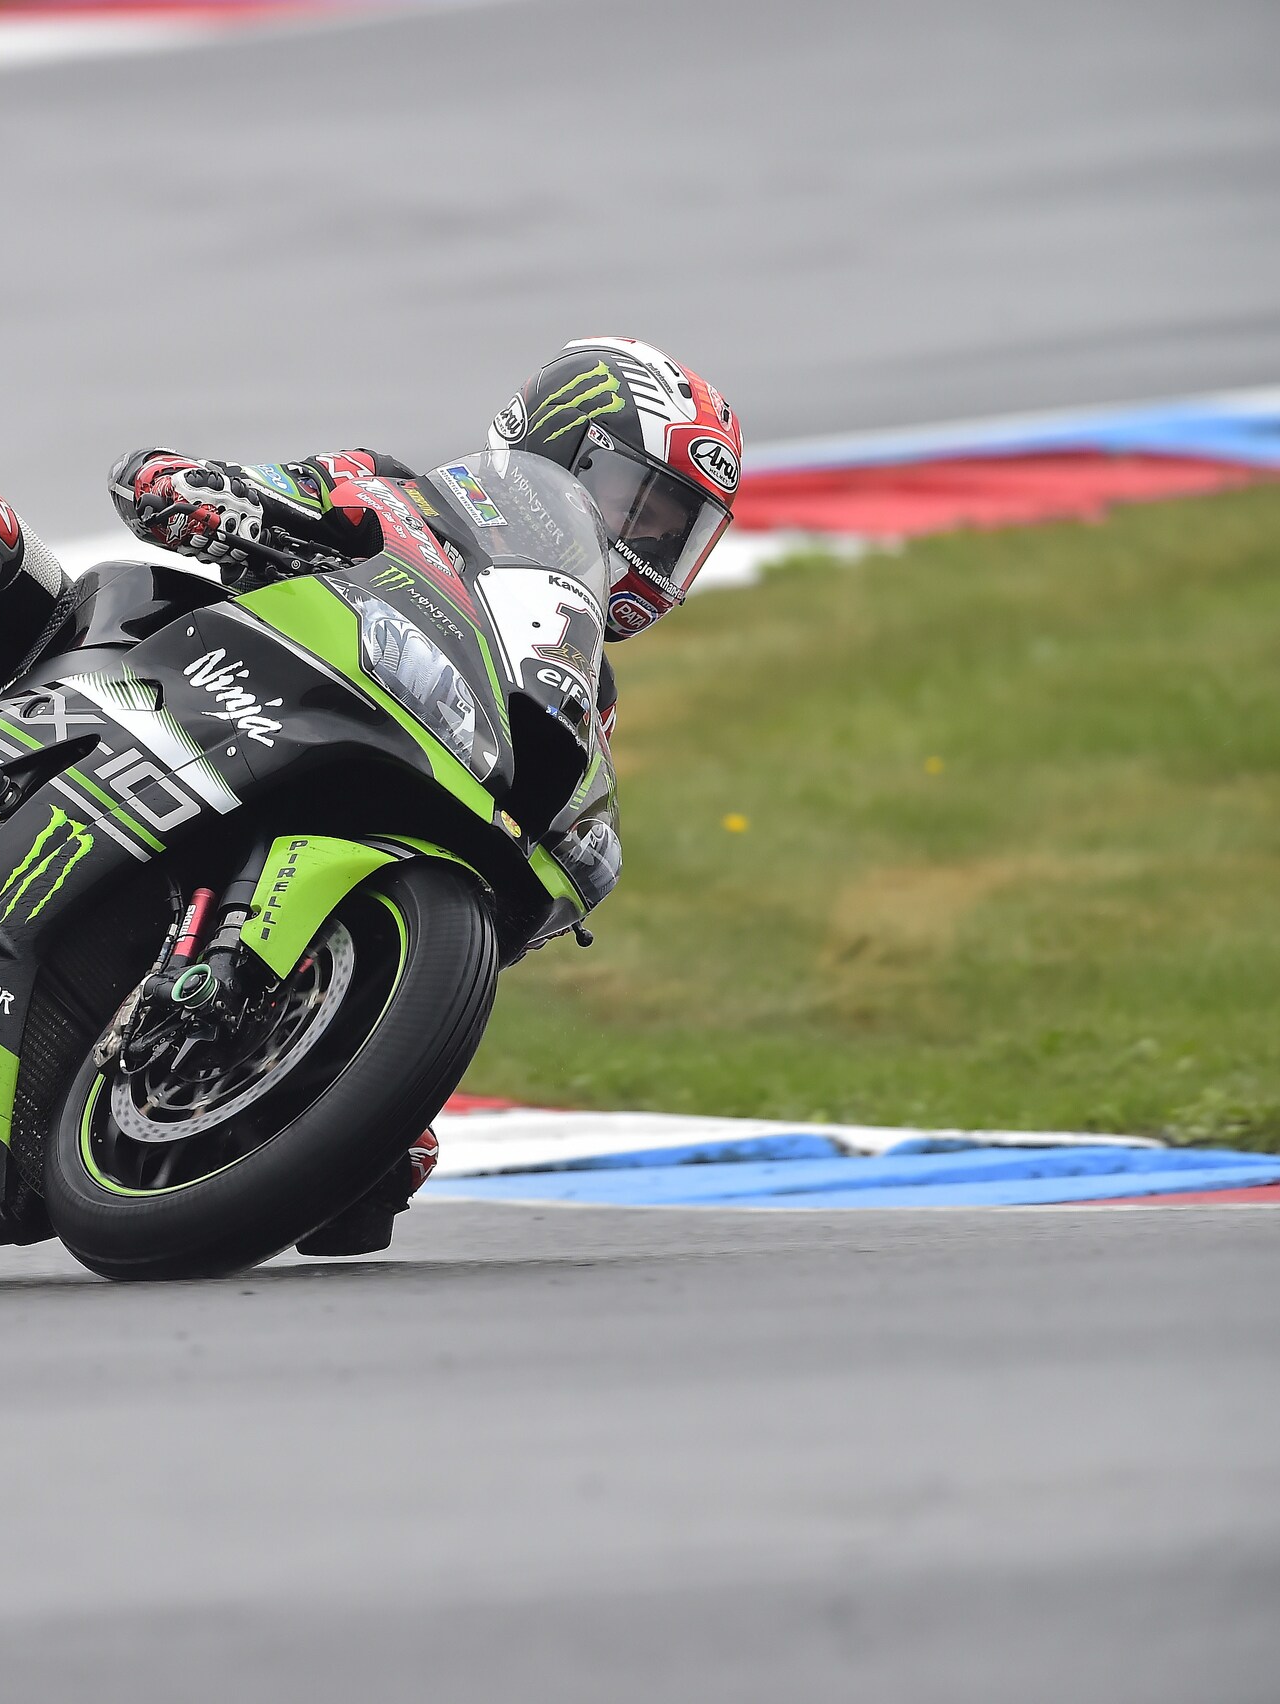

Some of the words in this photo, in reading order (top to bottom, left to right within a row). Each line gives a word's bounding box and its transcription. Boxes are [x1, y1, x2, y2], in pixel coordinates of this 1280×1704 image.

[694, 446, 737, 483] Arai
[510, 466, 564, 545] MONSTER
[406, 587, 465, 641] MONSTER
[548, 574, 604, 627] Kawasa
[615, 603, 648, 628] PATA
[183, 648, 284, 748] Ninja
[536, 668, 584, 700] elf
[260, 840, 308, 941] PIRELLI
